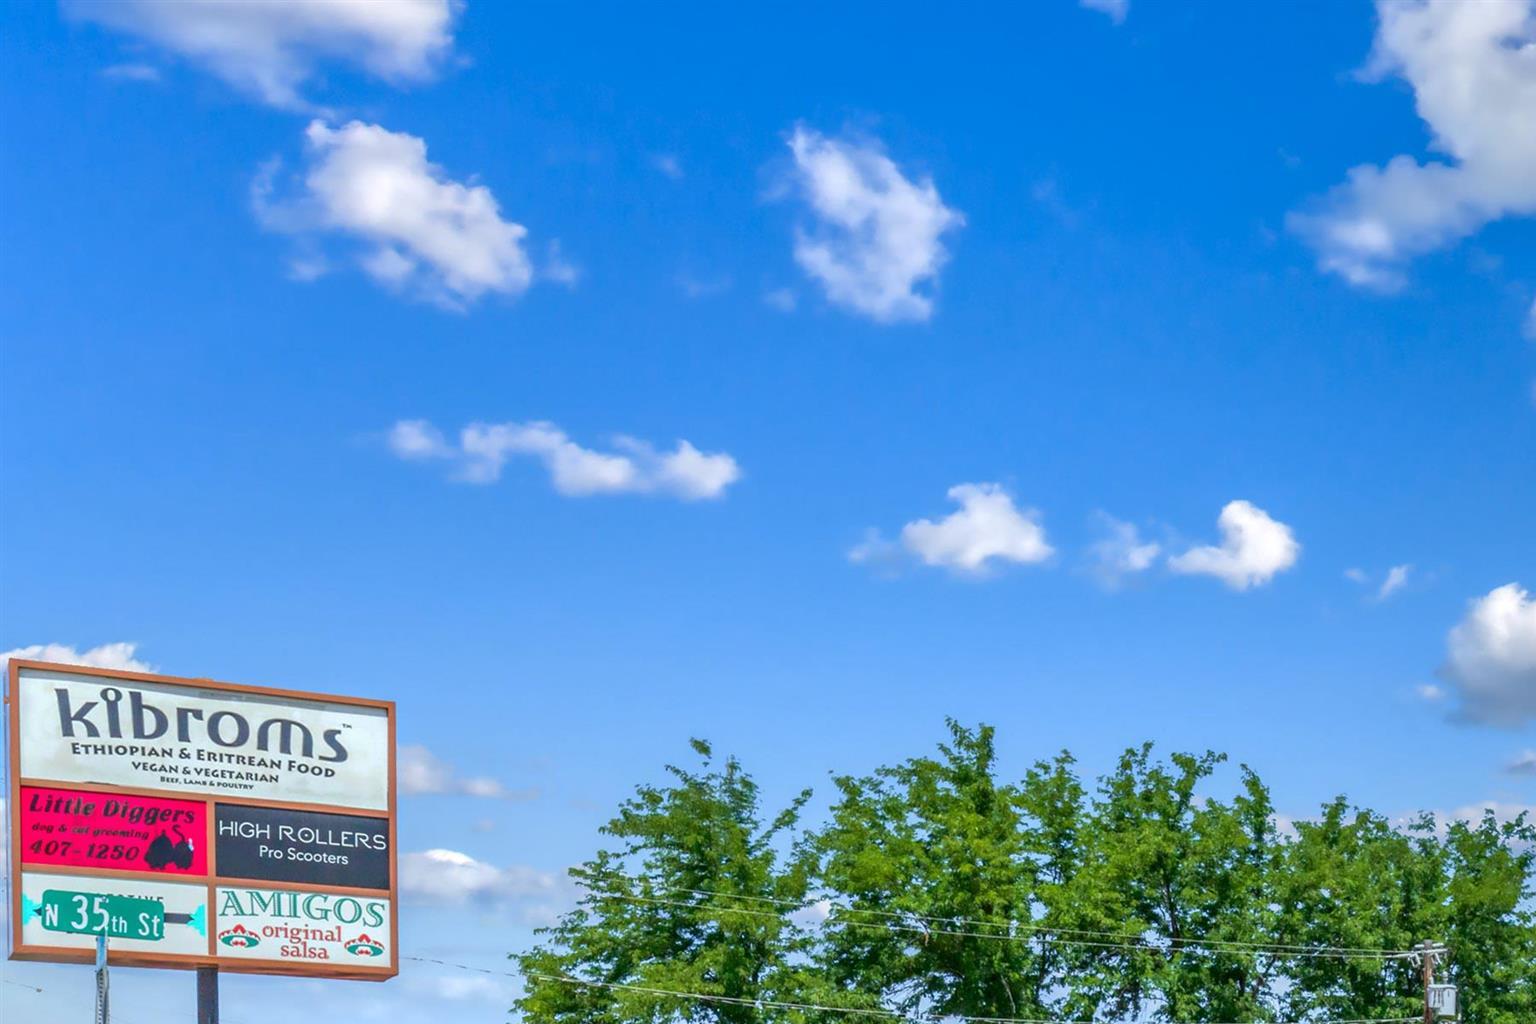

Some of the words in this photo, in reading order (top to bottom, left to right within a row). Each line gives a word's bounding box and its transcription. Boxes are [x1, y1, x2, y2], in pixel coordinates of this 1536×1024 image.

[71, 742, 173, 758] ETHIOPIAN
[178, 748, 191, 759] &
[196, 749, 282, 770] ERITREAN
[287, 760, 335, 778] FOOD
[132, 761, 178, 774] VEGAN
[181, 766, 191, 775] &
[194, 767, 279, 783] VEGETARIAN
[183, 778, 207, 786] LAMB
[216, 782, 254, 790] POULTRY
[29, 793, 96, 817] Little
[103, 799, 195, 825] Diggers
[31, 822, 54, 833] dog
[58, 824, 67, 833] &
[71, 825, 89, 835] cat
[92, 828, 149, 841] grooming
[219, 820, 270, 839] HIGH
[279, 825, 387, 850] ROLLERS
[259, 845, 283, 859] Pro
[287, 847, 349, 865] Scooters
[45, 903, 59, 927] N
[71, 894, 128, 934] 35th
[138, 912, 160, 937] St
[218, 890, 386, 928] AMIGOS
[262, 922, 342, 943] original
[280, 941, 330, 959] salsa
